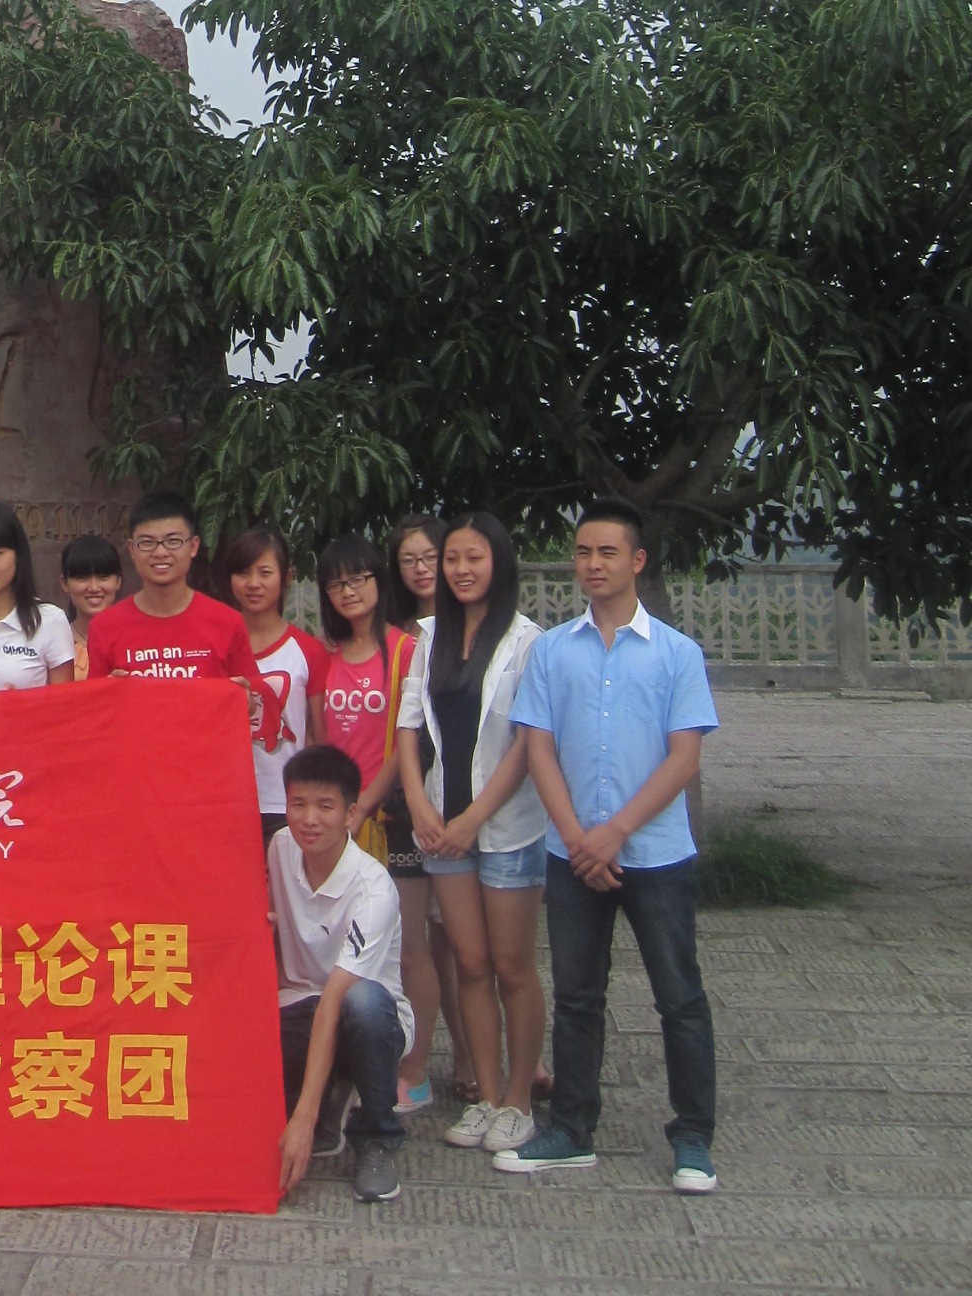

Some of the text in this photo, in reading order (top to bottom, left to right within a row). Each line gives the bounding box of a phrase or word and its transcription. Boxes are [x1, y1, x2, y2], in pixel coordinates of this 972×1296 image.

[126, 649, 131, 663] I
[134, 648, 159, 662] am
[162, 647, 182, 659] an
[323, 689, 386, 713] OCO
